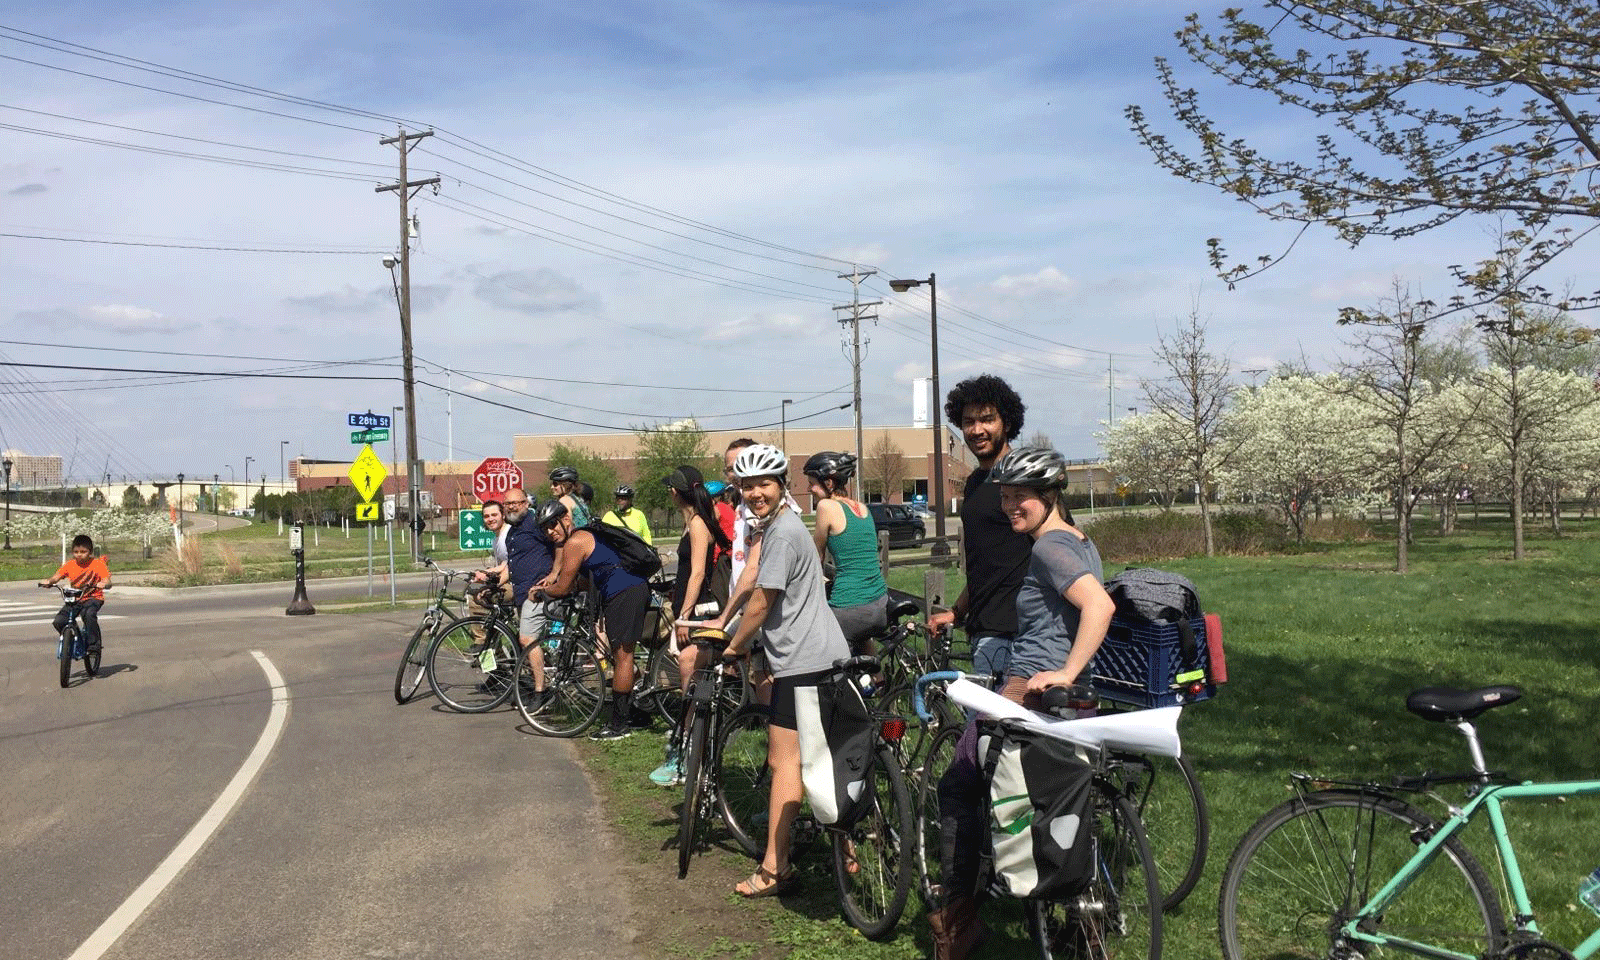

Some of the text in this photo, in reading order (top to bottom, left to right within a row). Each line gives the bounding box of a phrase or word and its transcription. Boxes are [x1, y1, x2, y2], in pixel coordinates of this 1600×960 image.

[350, 415, 389, 427] E 28th St
[476, 472, 520, 493] STOP
